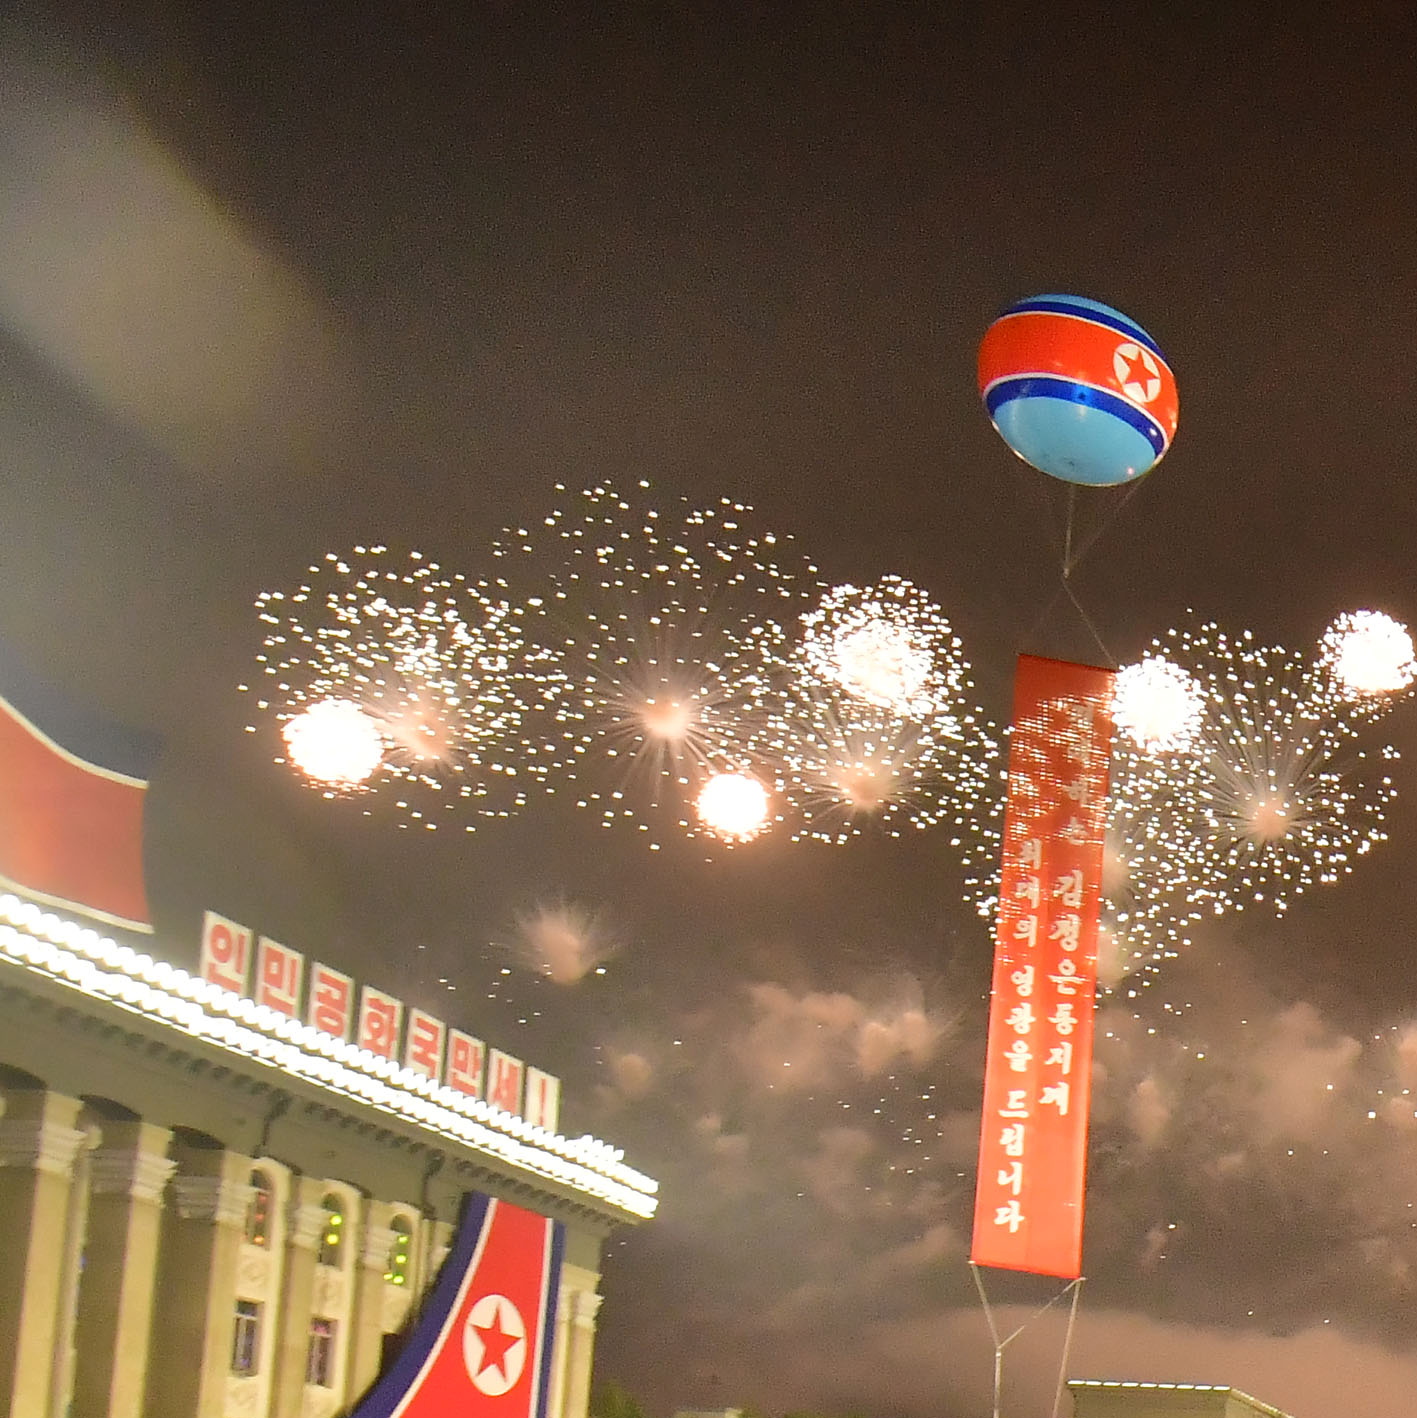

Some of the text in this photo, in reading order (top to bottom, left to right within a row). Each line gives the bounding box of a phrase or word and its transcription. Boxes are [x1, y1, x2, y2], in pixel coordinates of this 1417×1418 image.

[1046, 868, 1085, 994] 김정은
[1003, 964, 1037, 1073] 영광을
[1038, 1002, 1079, 1116] 동지께
[994, 1089, 1030, 1233] 드립니다
